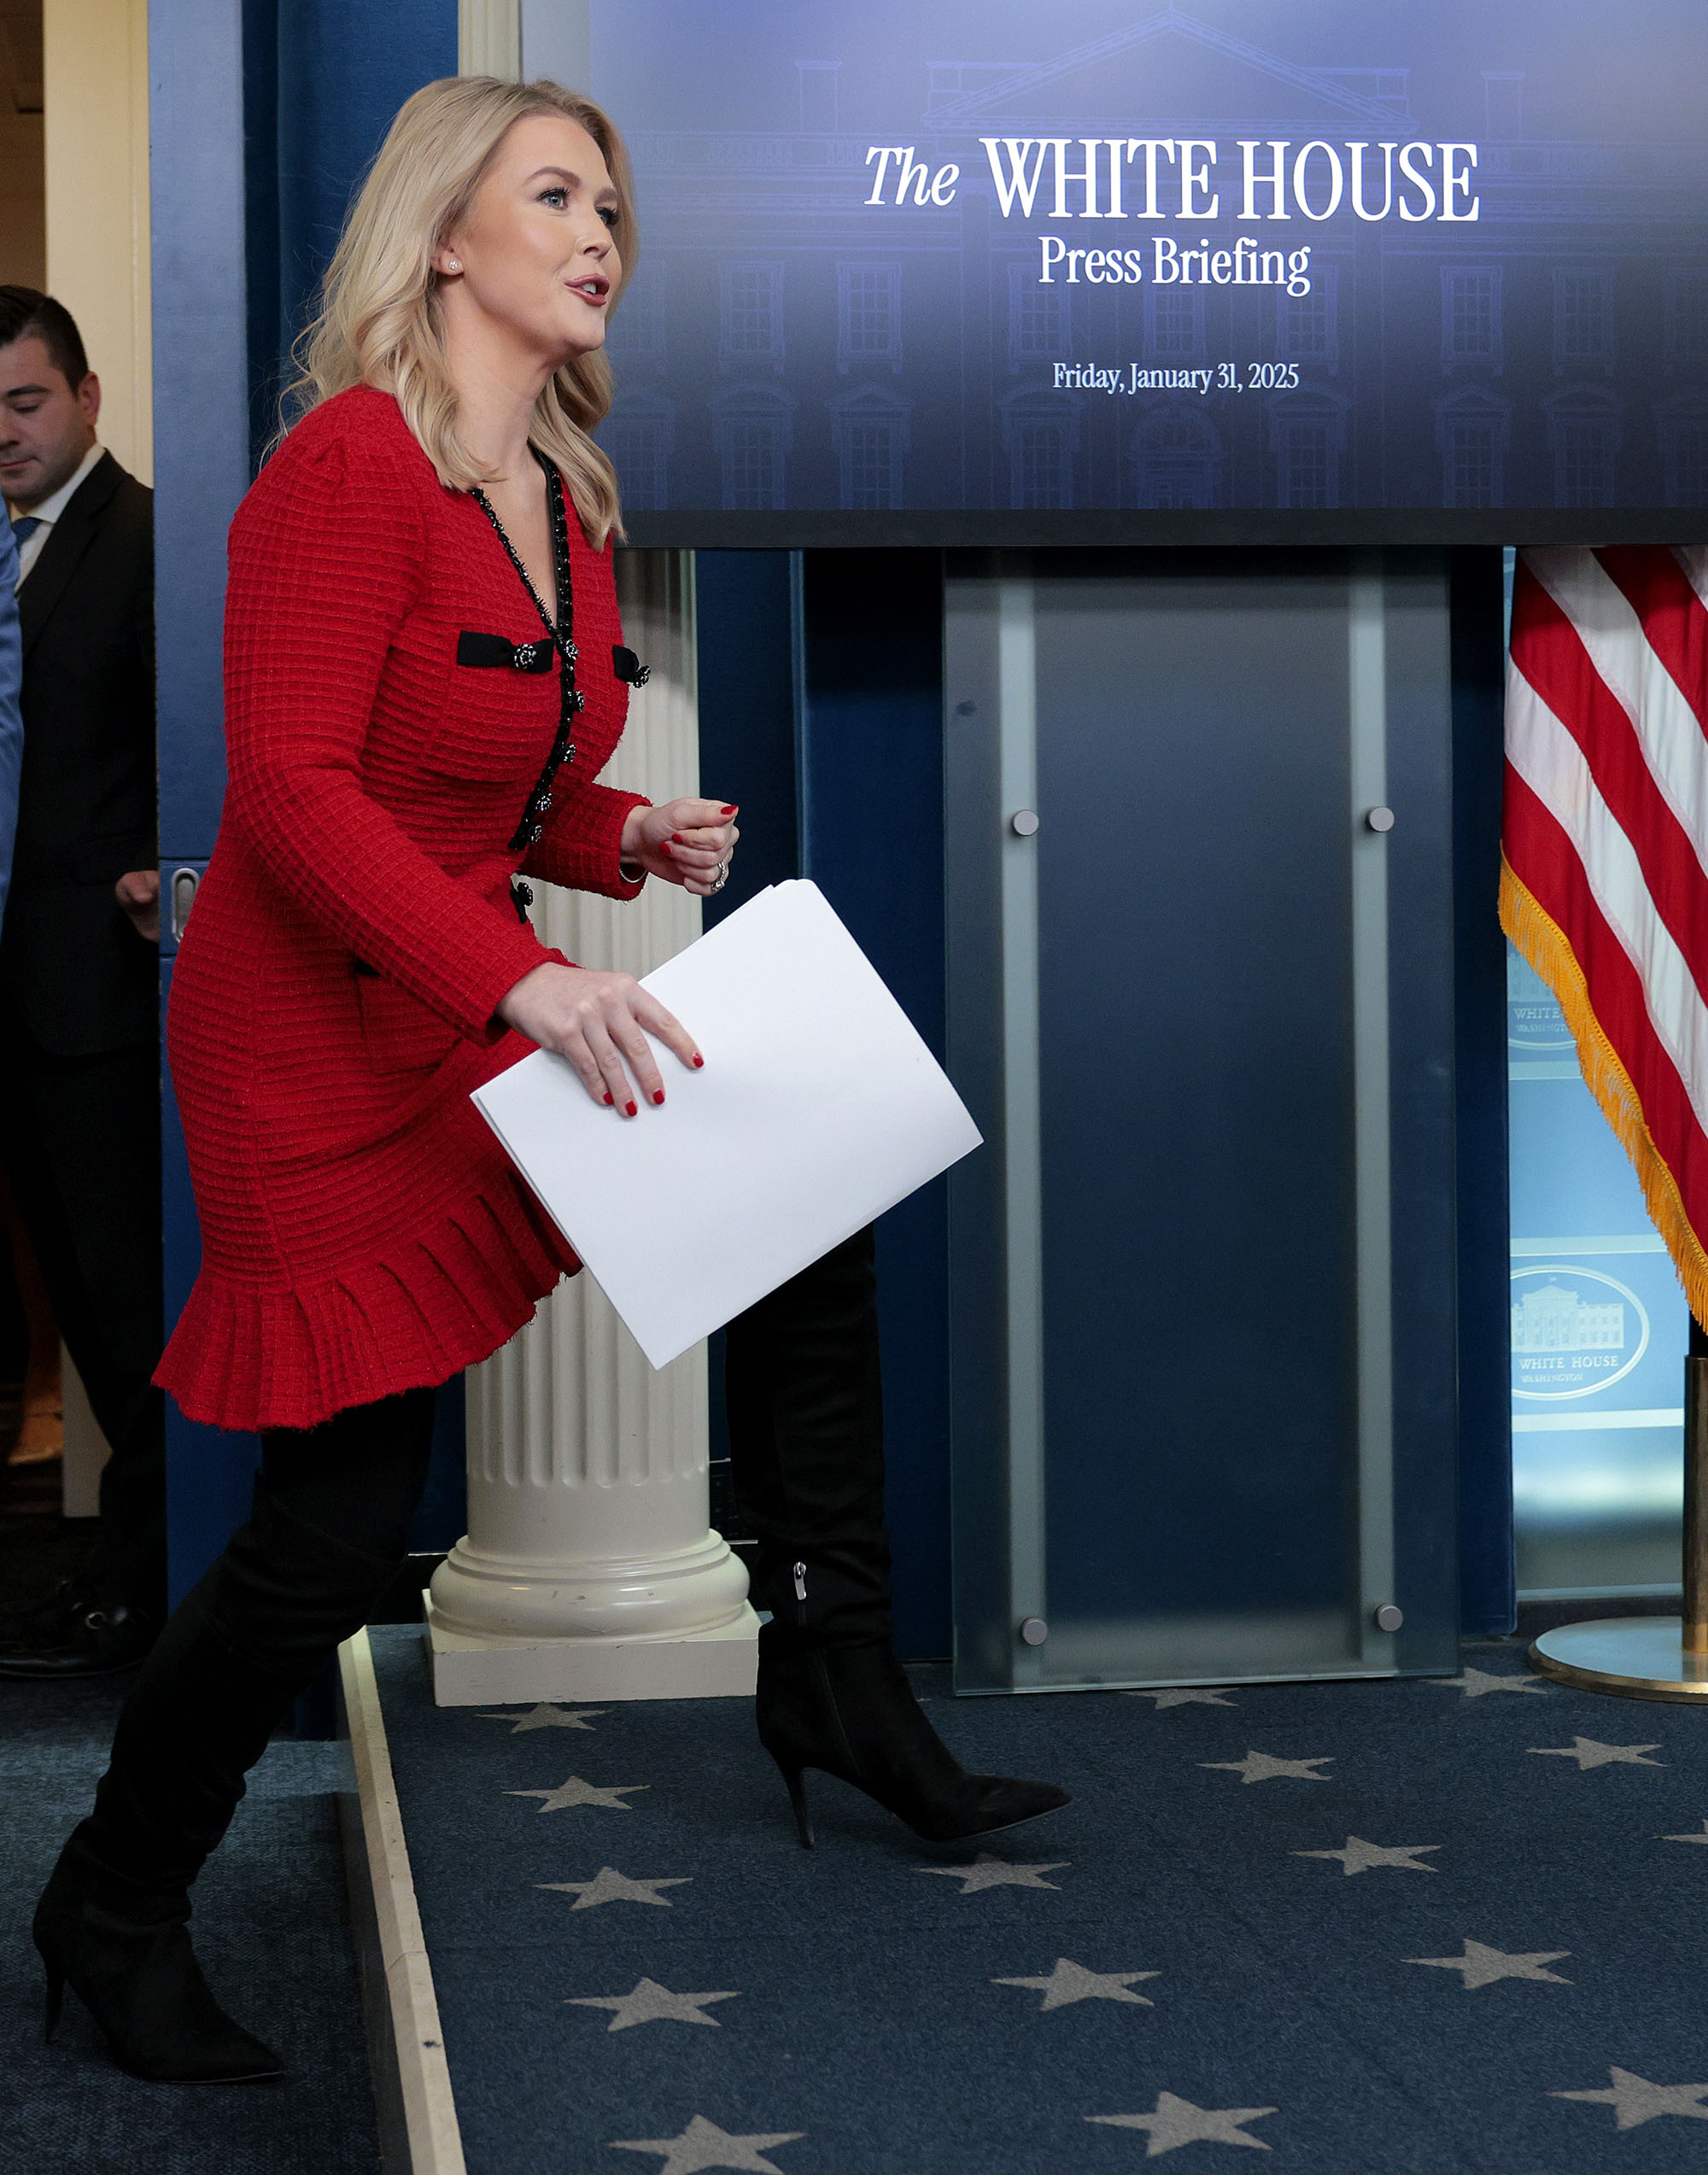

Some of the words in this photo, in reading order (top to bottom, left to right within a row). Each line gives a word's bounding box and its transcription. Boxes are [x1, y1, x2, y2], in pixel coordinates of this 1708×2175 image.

[863, 146, 960, 207] The
[979, 137, 1220, 219] WHITE
[1236, 140, 1479, 222] HOUSE
[1038, 236, 1142, 284] Press
[1151, 237, 1311, 297] Briefing
[1052, 362, 1125, 395] Friday,
[1127, 363, 1214, 395] January
[1217, 362, 1243, 394] 31,
[1248, 363, 1299, 389] 2025
[1513, 1008, 1560, 1019] WHITE
[1519, 1358, 1565, 1370] WHITE
[1571, 1356, 1619, 1368] HOUSE
[1522, 1373, 1583, 1383] WASHINGTON
